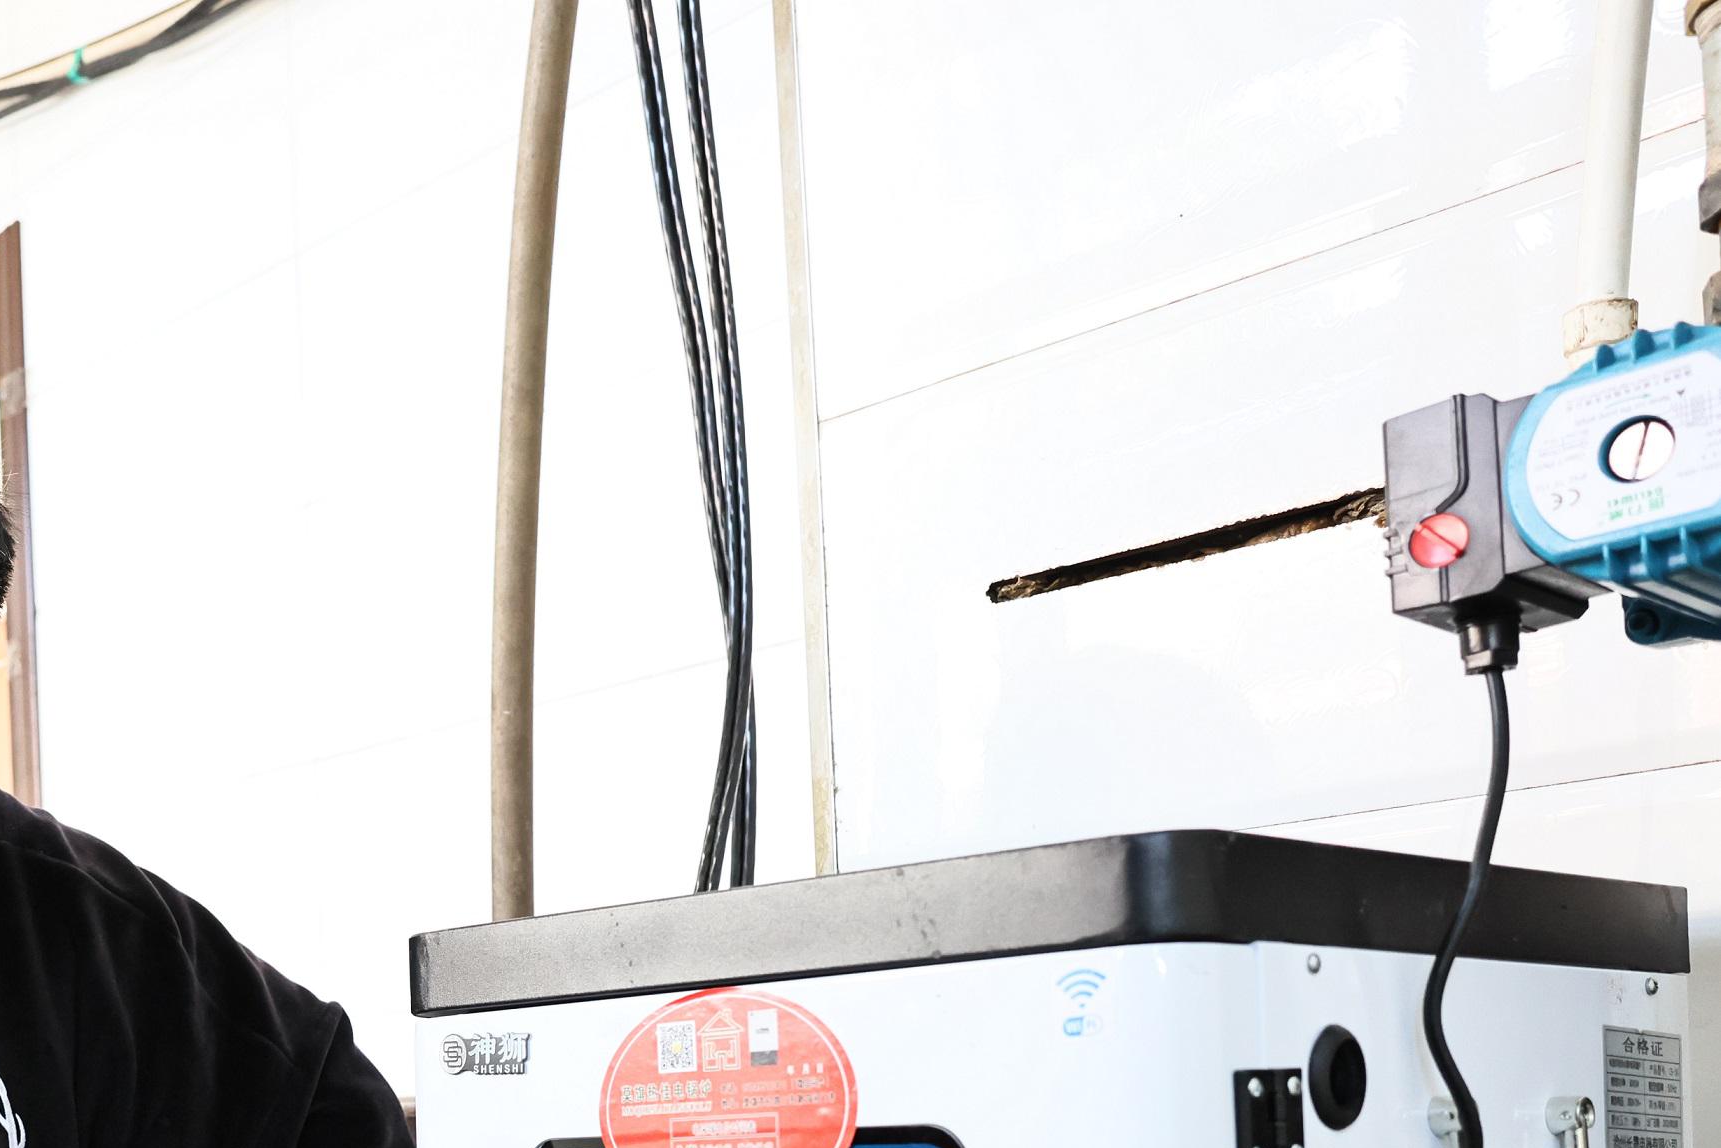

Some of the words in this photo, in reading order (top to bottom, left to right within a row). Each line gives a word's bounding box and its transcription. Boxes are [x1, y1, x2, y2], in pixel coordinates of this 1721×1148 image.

[468, 1032, 530, 1064] 神狮
[1622, 1036, 1664, 1058] 合格证
[473, 1063, 523, 1074] SHENSHI
